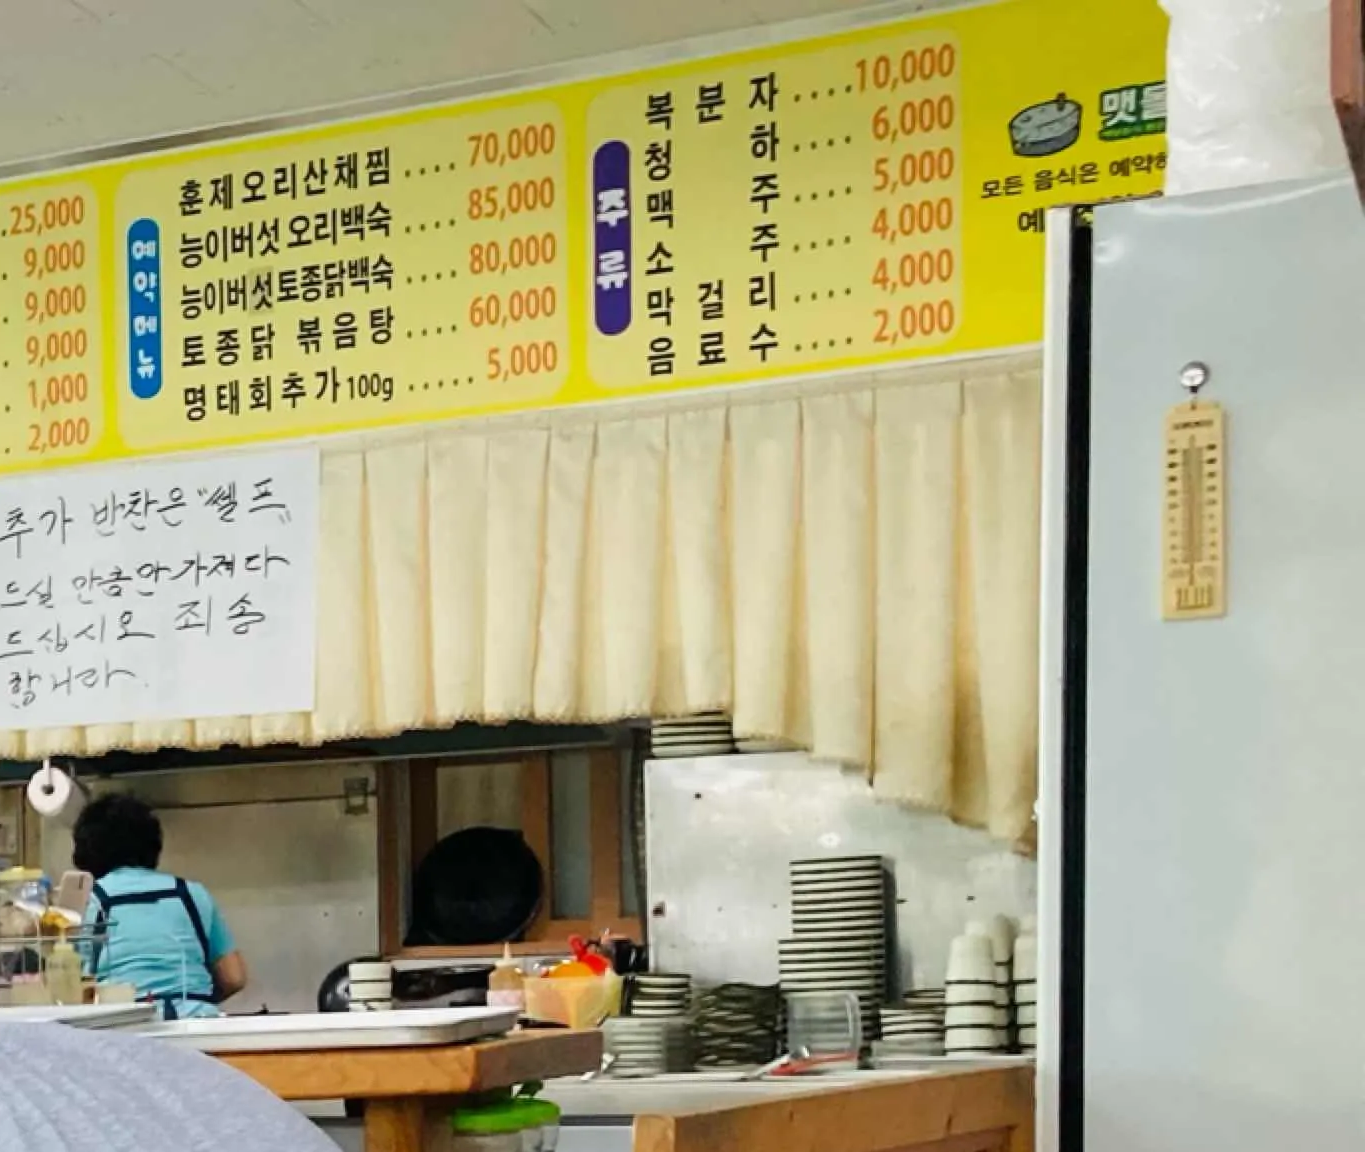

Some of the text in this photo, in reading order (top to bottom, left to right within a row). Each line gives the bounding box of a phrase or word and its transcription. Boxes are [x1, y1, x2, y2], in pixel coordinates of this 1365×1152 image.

[855, 42, 955, 94] 10,000
[871, 94, 955, 142] 6,000
[468, 122, 556, 168] 70,000
[872, 146, 955, 192] 5,000
[980, 175, 1024, 199] 모든
[1034, 161, 1100, 193] 음식은
[10, 196, 84, 238] 25,000
[468, 176, 556, 221] 85,000
[871, 197, 954, 242] 4,000
[24, 240, 85, 280] 9,000
[469, 232, 557, 275] 80,000
[595, 187, 628, 290] 주류
[871, 248, 954, 293] 4,000
[25, 284, 86, 324] 9,000
[132, 239, 157, 380] 예약메뉴
[469, 286, 557, 328] 60,000
[872, 299, 955, 345] 2,000
[26, 329, 88, 367] 9,000
[486, 341, 558, 381] 5,000
[29, 373, 88, 412] 1,000
[29, 417, 90, 453] 2,000
[90, 487, 187, 537] 반찬은
[175, 592, 266, 636] 죄송
